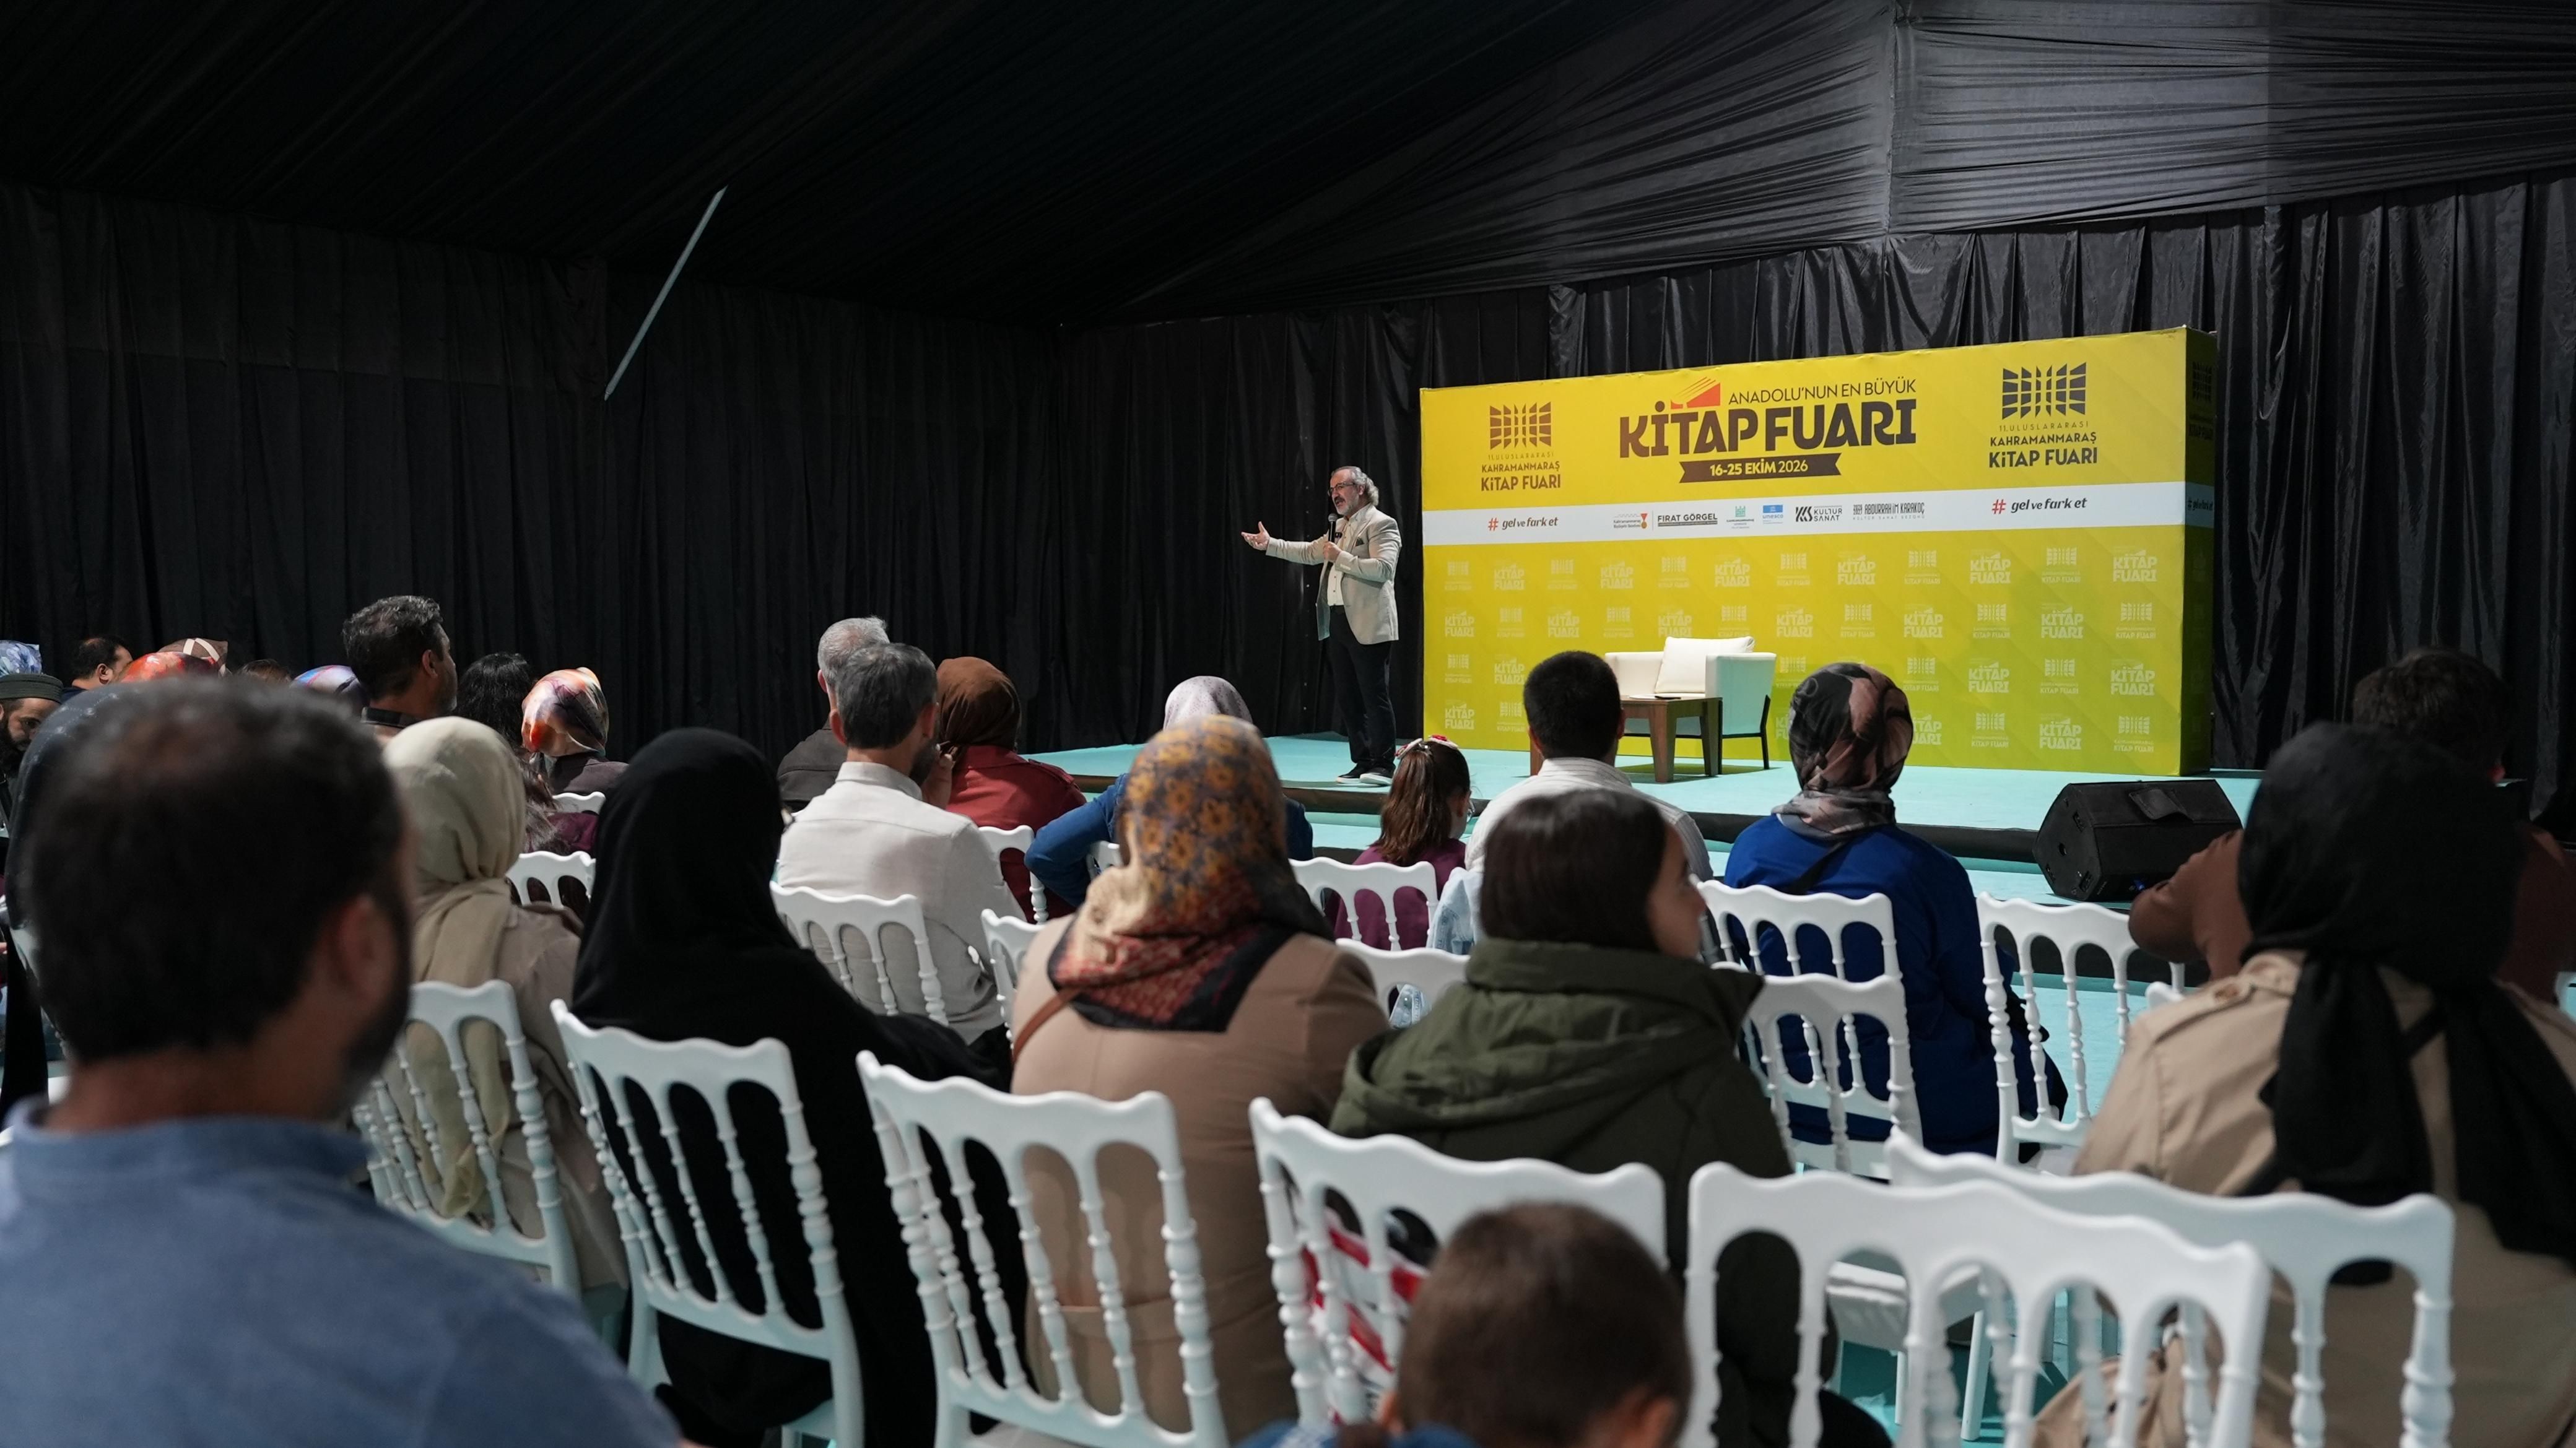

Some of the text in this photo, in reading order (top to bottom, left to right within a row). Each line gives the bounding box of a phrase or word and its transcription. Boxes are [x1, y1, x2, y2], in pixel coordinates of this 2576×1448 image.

[1728, 376, 1917, 405] ANADOLU'NUN EN BÜYÜK
[1619, 398, 1917, 458] KİTAP FUARI
[1990, 431, 2097, 447] KAHRAMANMARAŞ
[2045, 446, 2098, 466] FUARI
[1481, 461, 1560, 474] KAHRAMANMARAŞ
[1709, 458, 1809, 477] 16-25 EKİM 2026
[1522, 474, 1561, 490] FUARI
[2011, 499, 2030, 513] gel
[2044, 498, 2073, 509] fark
[2074, 497, 2087, 508] et
[1502, 518, 1516, 531] gel
[1526, 517, 1547, 527] fark
[1549, 517, 1559, 526] et
[1657, 514, 1681, 522] FIRAT
[1683, 513, 1718, 521] GÖRGEL
[1913, 733, 1943, 745] UARI
